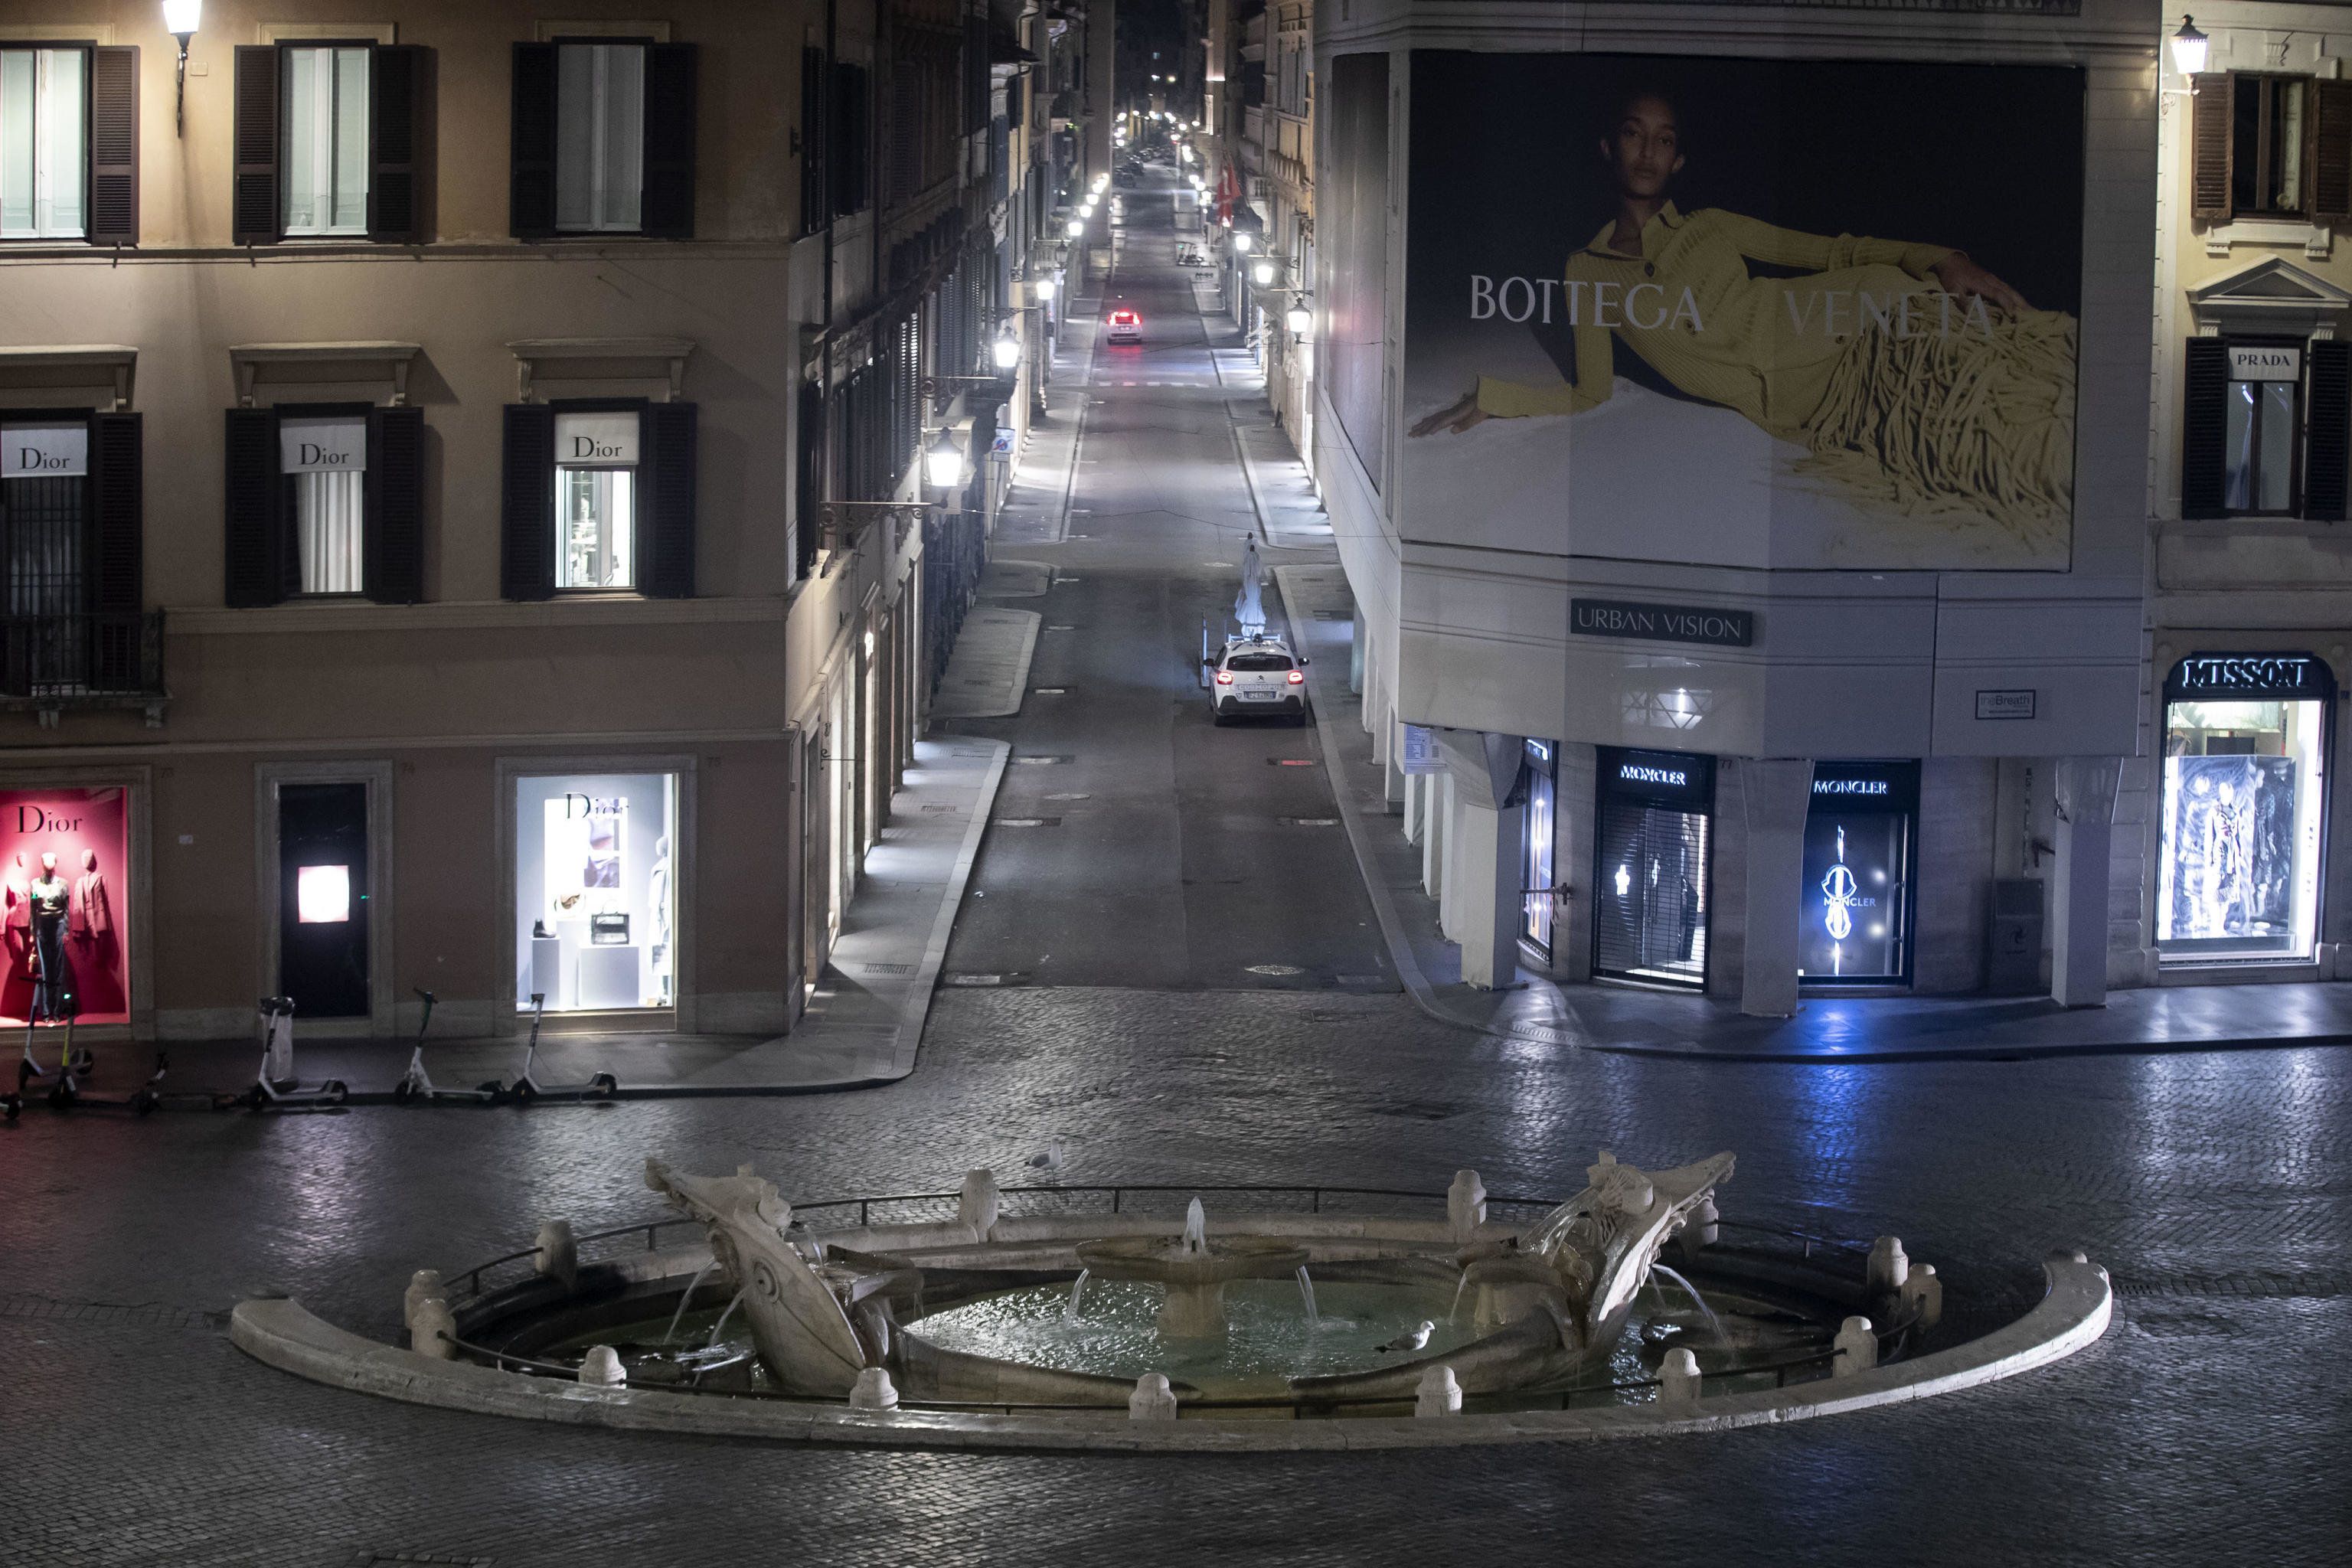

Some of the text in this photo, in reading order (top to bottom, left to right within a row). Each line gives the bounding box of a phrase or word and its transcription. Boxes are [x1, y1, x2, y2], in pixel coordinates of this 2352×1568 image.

[1470, 275, 1993, 339] BOTTEGA VENETA
[2237, 354, 2290, 366] PRADA
[18, 447, 70, 469] Dior
[299, 443, 349, 466] Dior
[573, 436, 622, 459] Dior
[1579, 607, 1740, 639] URBAN VISION
[2183, 658, 2311, 688] MISSONI
[1620, 765, 1686, 786] MONCLER
[1814, 780, 1888, 794] MONCLER
[564, 792, 630, 819] Dior
[16, 805, 83, 833] Dior
